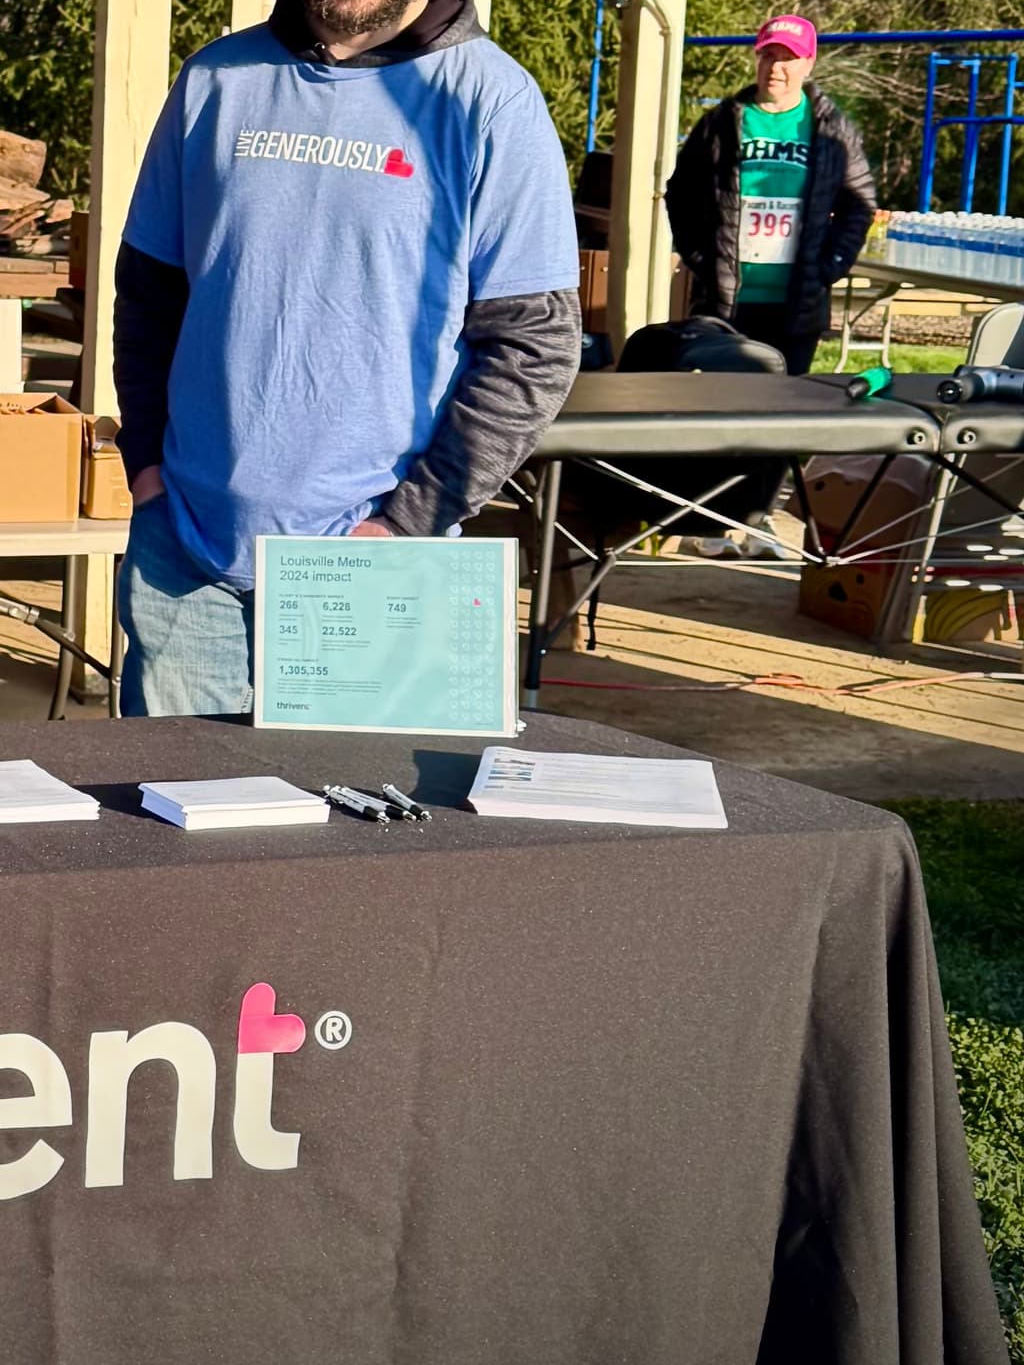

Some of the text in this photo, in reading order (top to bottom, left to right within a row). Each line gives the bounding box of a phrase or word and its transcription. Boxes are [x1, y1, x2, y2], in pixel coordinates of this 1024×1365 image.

[234, 129, 255, 157] LIVE
[748, 212, 792, 237] 396
[280, 555, 372, 568] Louisville Metro
[279, 570, 352, 582] 2024 impact
[279, 600, 407, 613] 266 6,228 749
[279, 625, 357, 637] 345 22,522
[279, 665, 329, 676] 1,305,355
